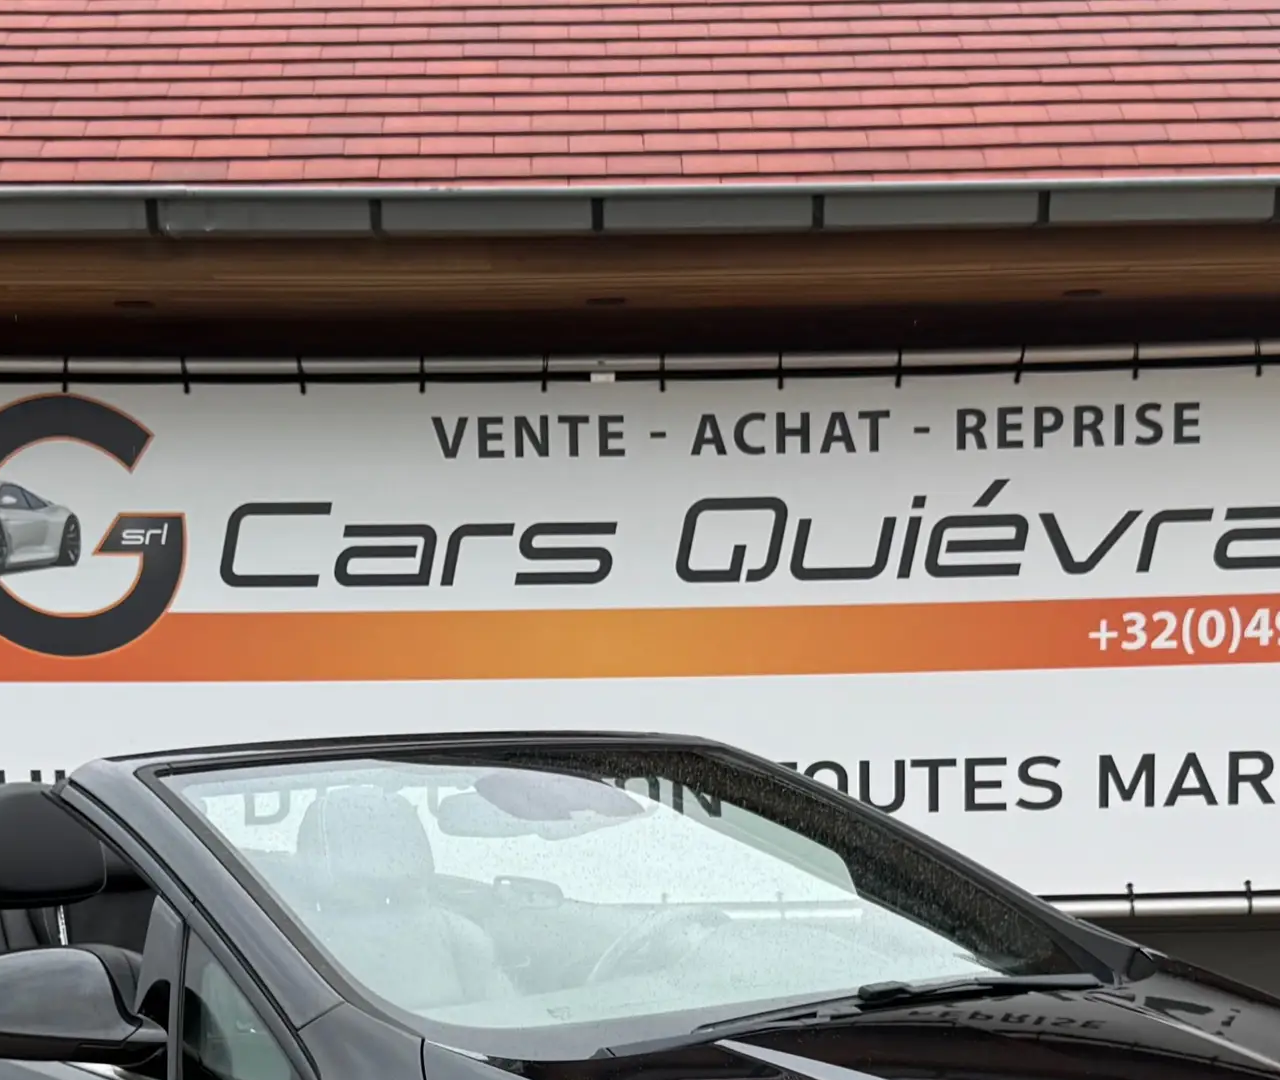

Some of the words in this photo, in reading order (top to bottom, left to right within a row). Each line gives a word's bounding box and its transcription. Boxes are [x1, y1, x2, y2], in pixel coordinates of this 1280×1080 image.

[431, 415, 626, 459] VENTE
[690, 409, 891, 456] ACHAT
[955, 401, 1202, 451] REPRISE
[121, 522, 169, 546] srl
[220, 501, 619, 588] Cars
